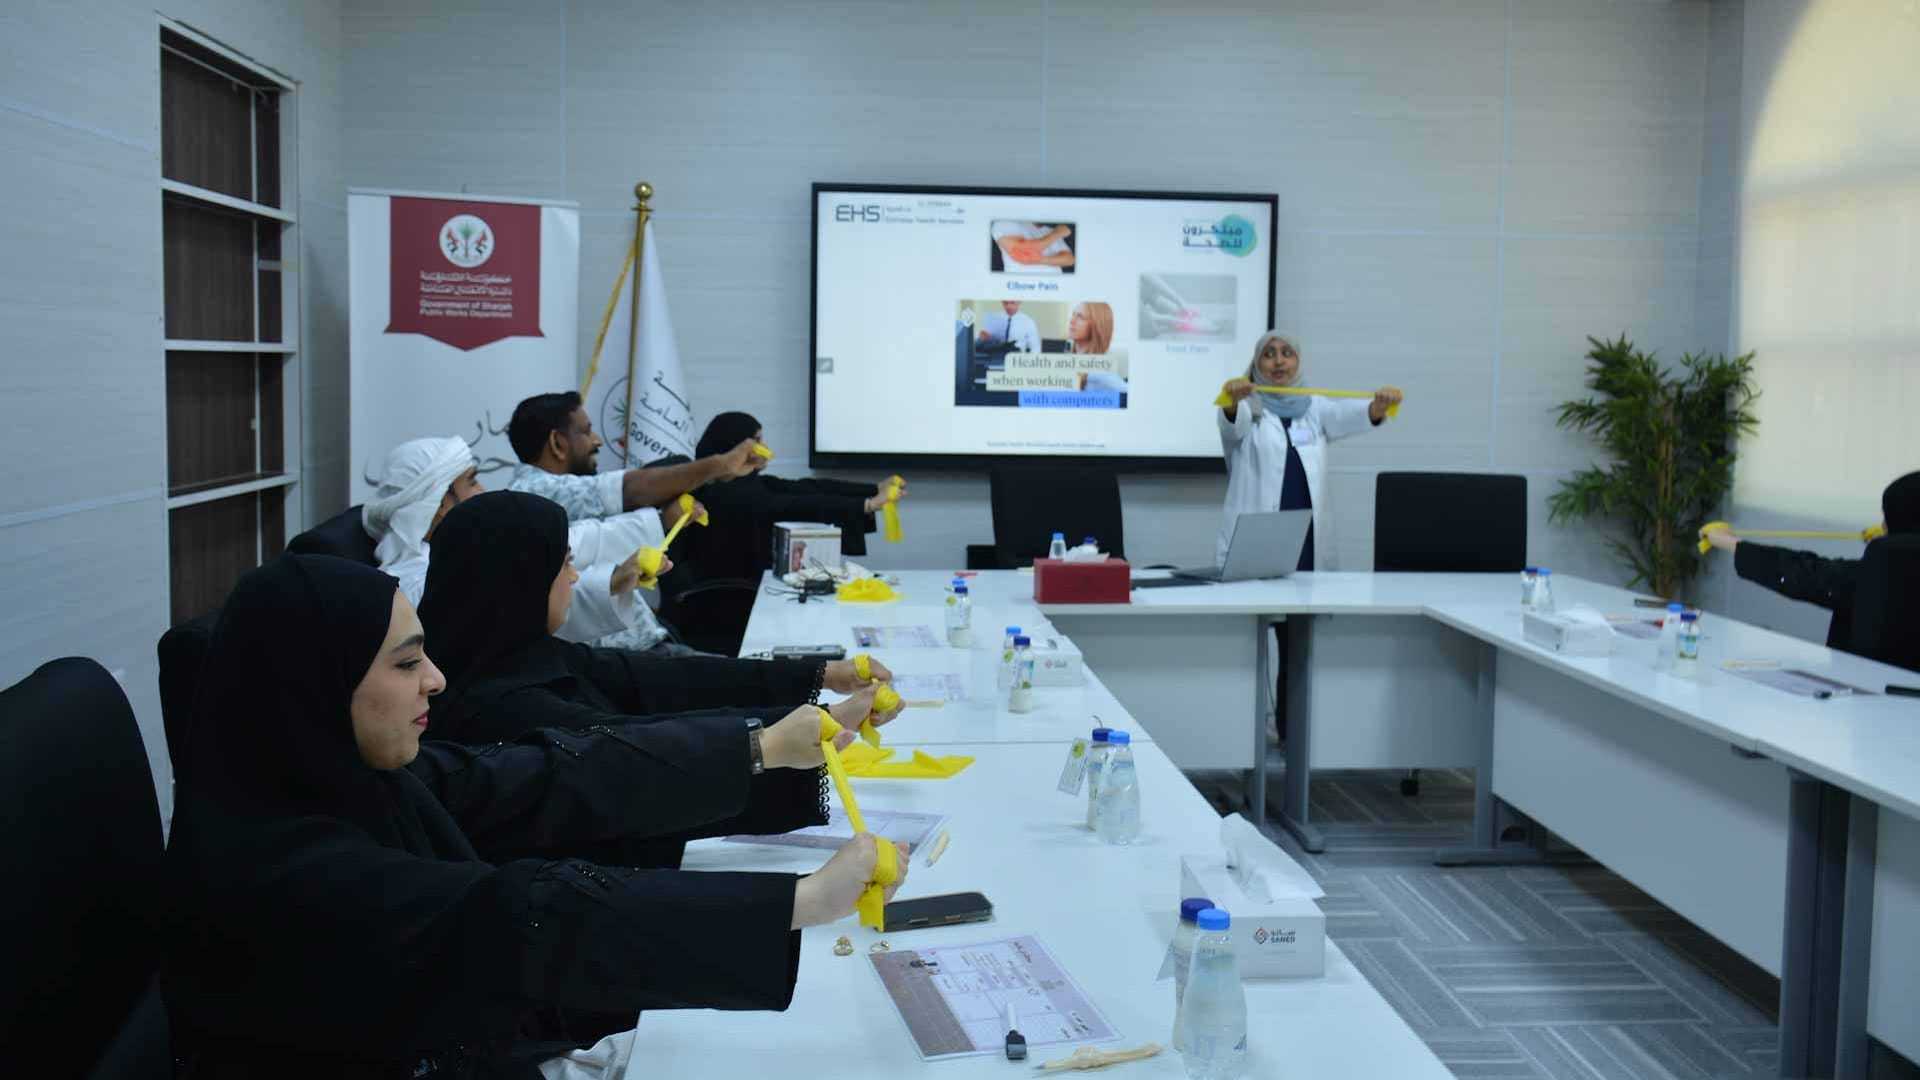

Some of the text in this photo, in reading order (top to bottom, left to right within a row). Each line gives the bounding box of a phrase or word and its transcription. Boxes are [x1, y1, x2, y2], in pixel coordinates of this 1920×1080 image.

[836, 204, 880, 222] EHS
[1007, 281, 1059, 292] Elbow Pain
[420, 300, 470, 310] Government
[1012, 356, 1113, 372] Health and safety
[992, 374, 1073, 389] when working
[1023, 392, 1113, 408] with computers
